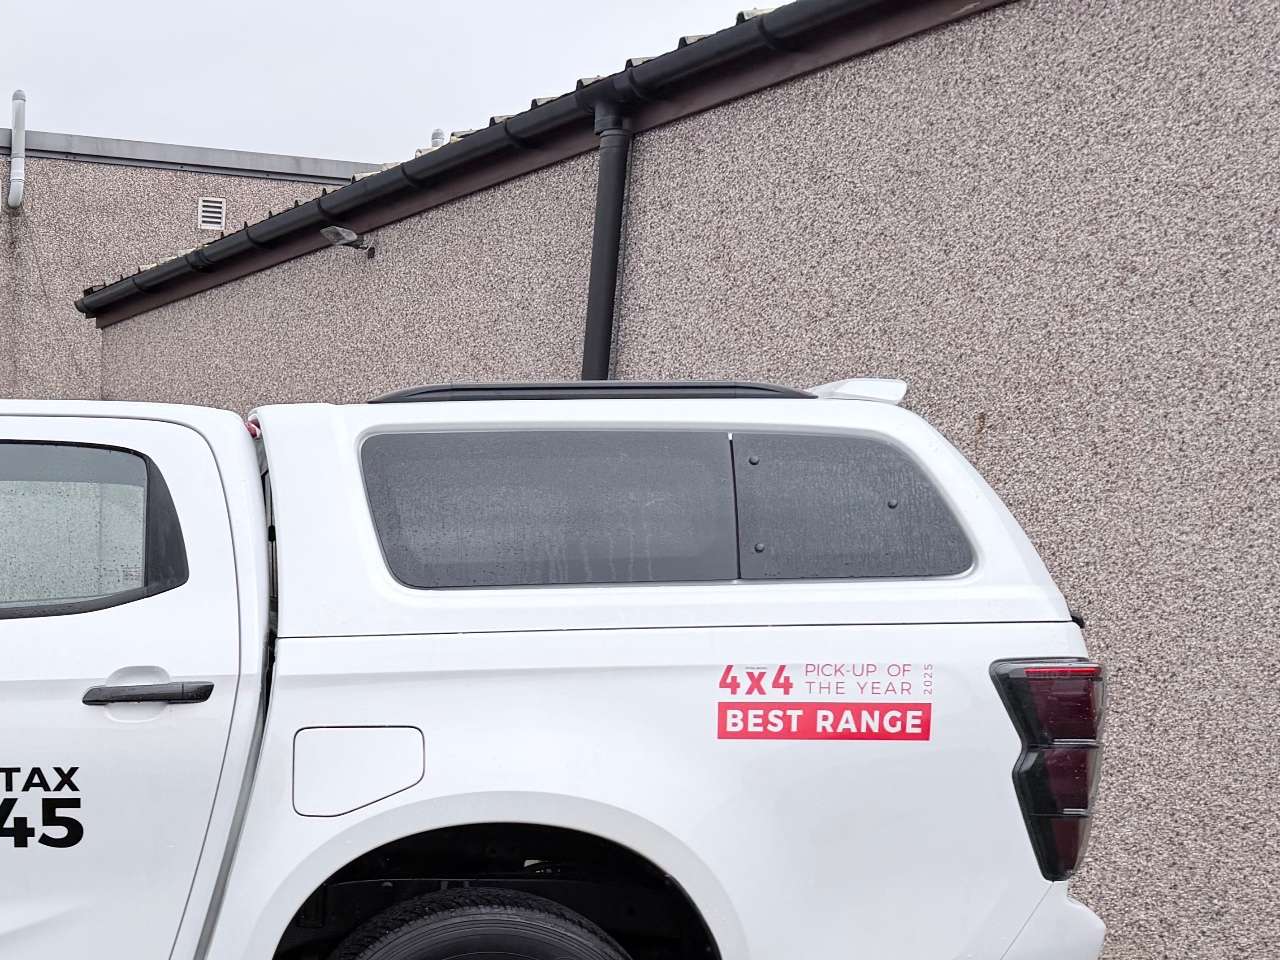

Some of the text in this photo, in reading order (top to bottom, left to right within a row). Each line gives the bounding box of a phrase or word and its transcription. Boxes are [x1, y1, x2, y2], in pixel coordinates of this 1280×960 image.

[718, 664, 794, 696] 4x4
[804, 663, 912, 677] PICK-UP OF
[923, 663, 934, 696] 2025
[805, 681, 912, 695] THE YEAR
[726, 709, 923, 734] BEST RANGE
